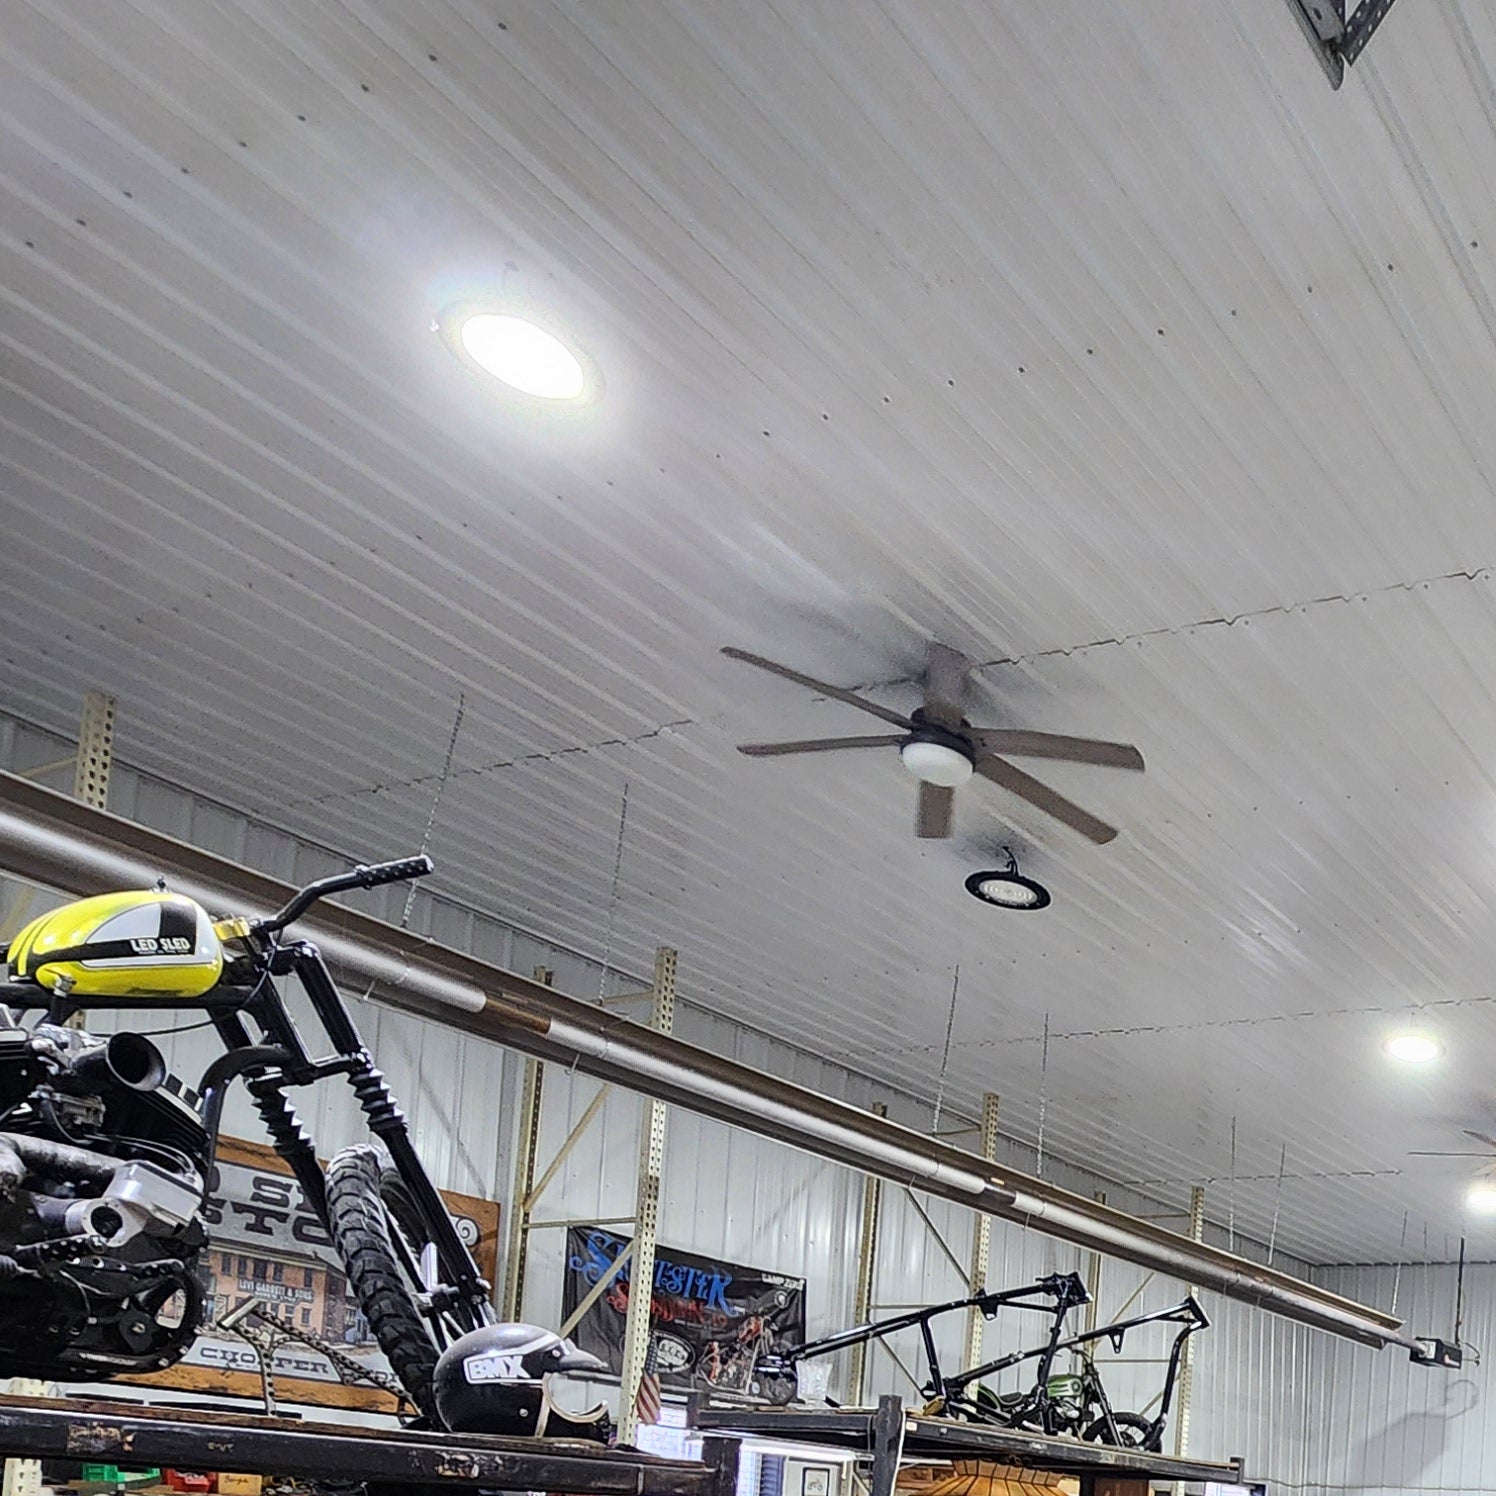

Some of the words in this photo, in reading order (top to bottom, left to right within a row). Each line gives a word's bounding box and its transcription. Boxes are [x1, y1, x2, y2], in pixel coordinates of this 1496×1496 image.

[130, 938, 158, 953] LED
[160, 937, 191, 951] SLED
[199, 1347, 329, 1374] CHOPER
[469, 1355, 531, 1379] BMX
